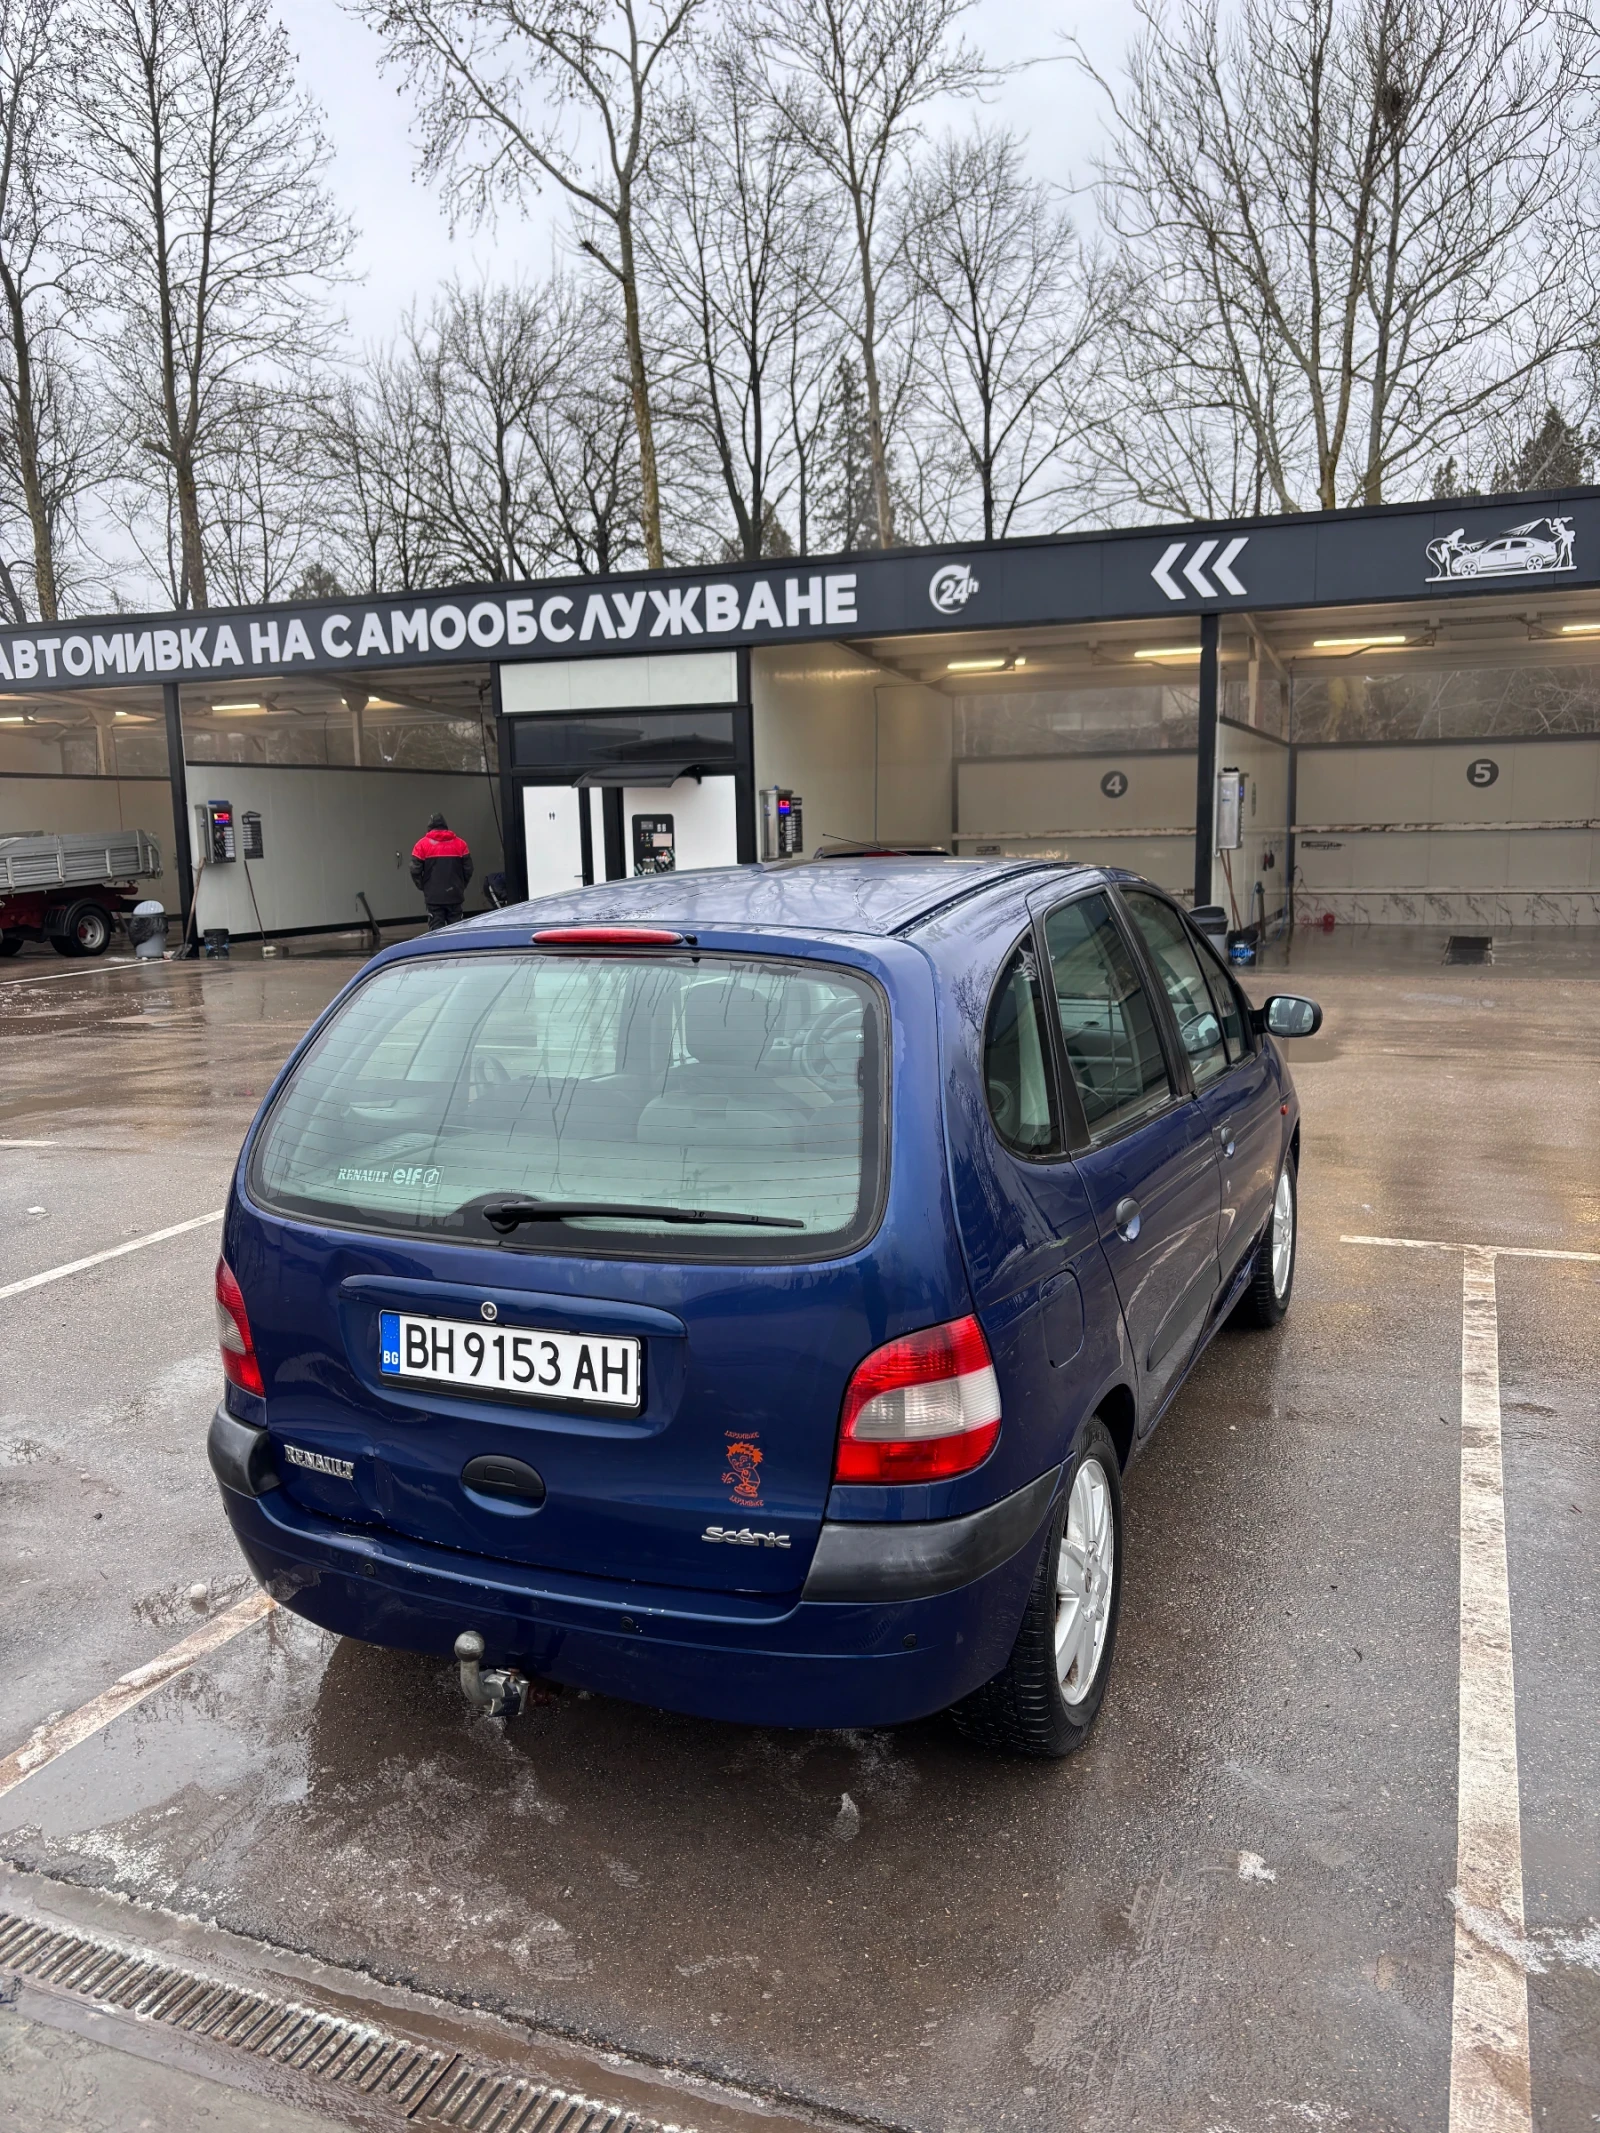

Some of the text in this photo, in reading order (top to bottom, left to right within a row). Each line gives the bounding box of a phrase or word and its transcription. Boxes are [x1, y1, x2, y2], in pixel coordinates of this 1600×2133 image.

[939, 578, 980, 605] 24h
[249, 618, 316, 664] НА
[321, 573, 858, 658] САМООБСЛУЖВАНЕ
[1106, 775, 1121, 794] 4
[1474, 763, 1492, 783] 5
[338, 1167, 423, 1185] RENAULT elf
[383, 1350, 399, 1365] BG
[464, 1331, 561, 1386] 9153
[283, 1444, 355, 1481] RENAULT
